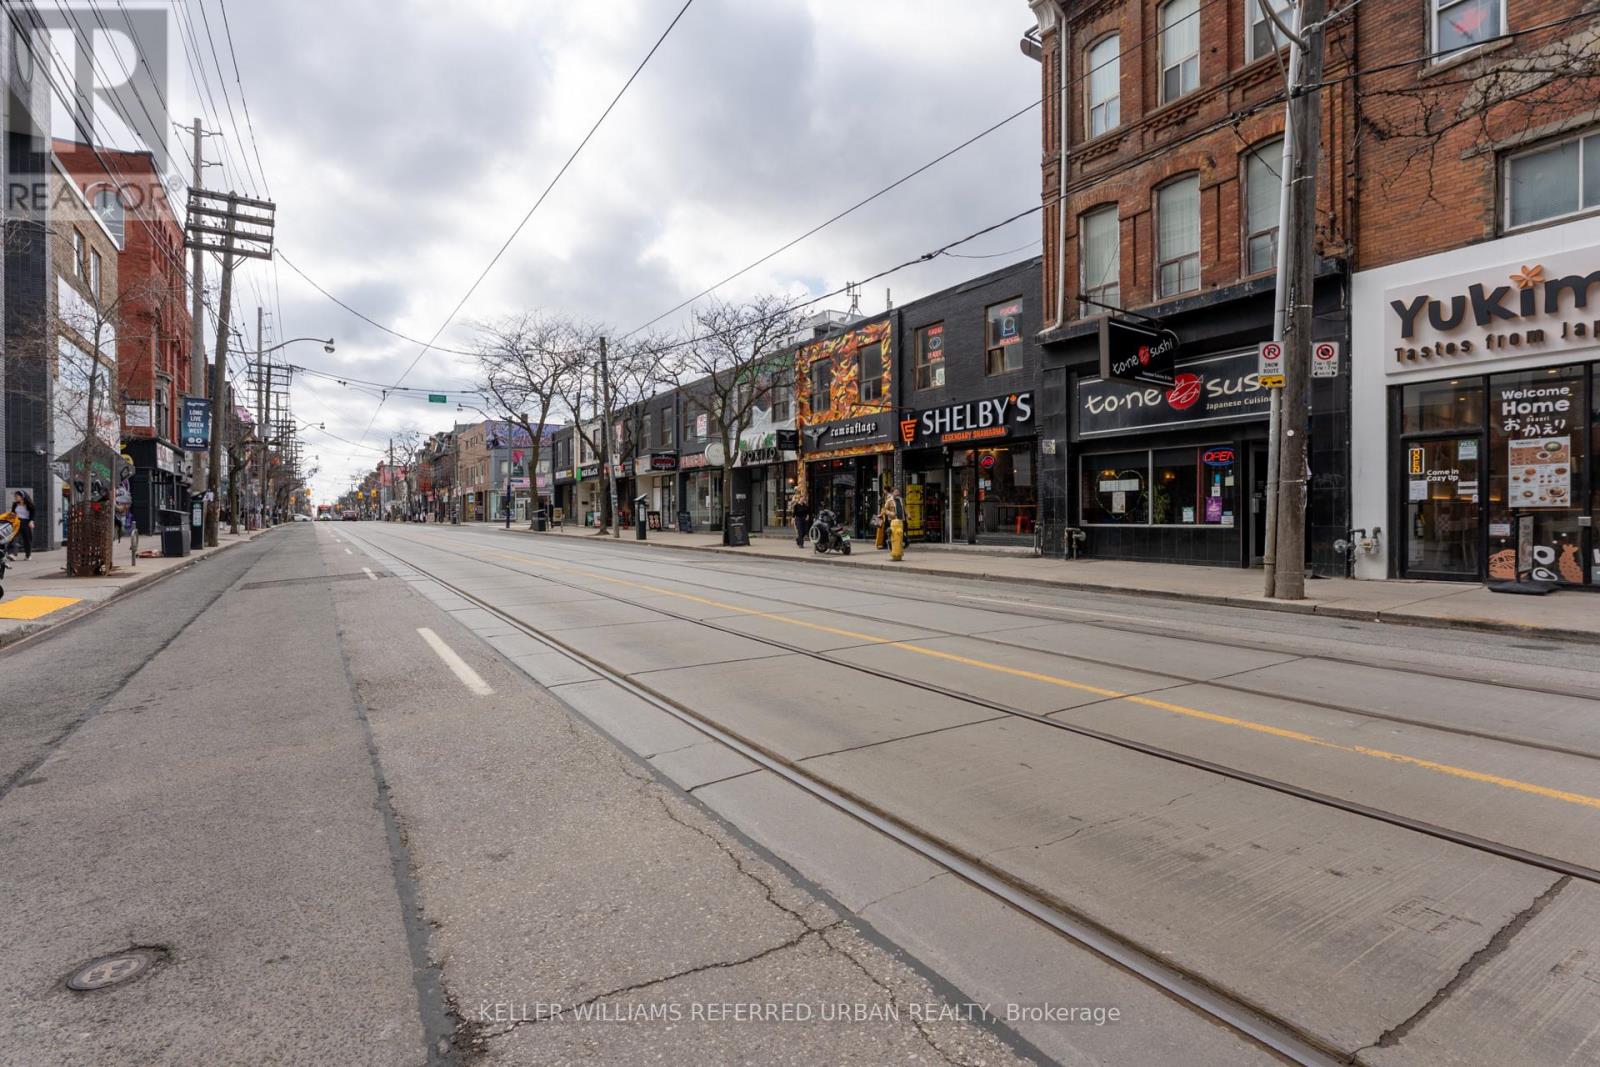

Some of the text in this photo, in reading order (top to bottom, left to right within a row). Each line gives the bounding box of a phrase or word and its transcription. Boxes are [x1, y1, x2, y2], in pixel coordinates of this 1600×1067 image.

[1150, 337, 1173, 358] sushi
[1394, 340, 1473, 362] Tastes
[1485, 329, 1545, 350] from
[1501, 386, 1570, 400] Welcome
[922, 393, 1032, 436] SHELBY'S
[1205, 400, 1242, 411] Japanese
[1501, 399, 1570, 416] Home
